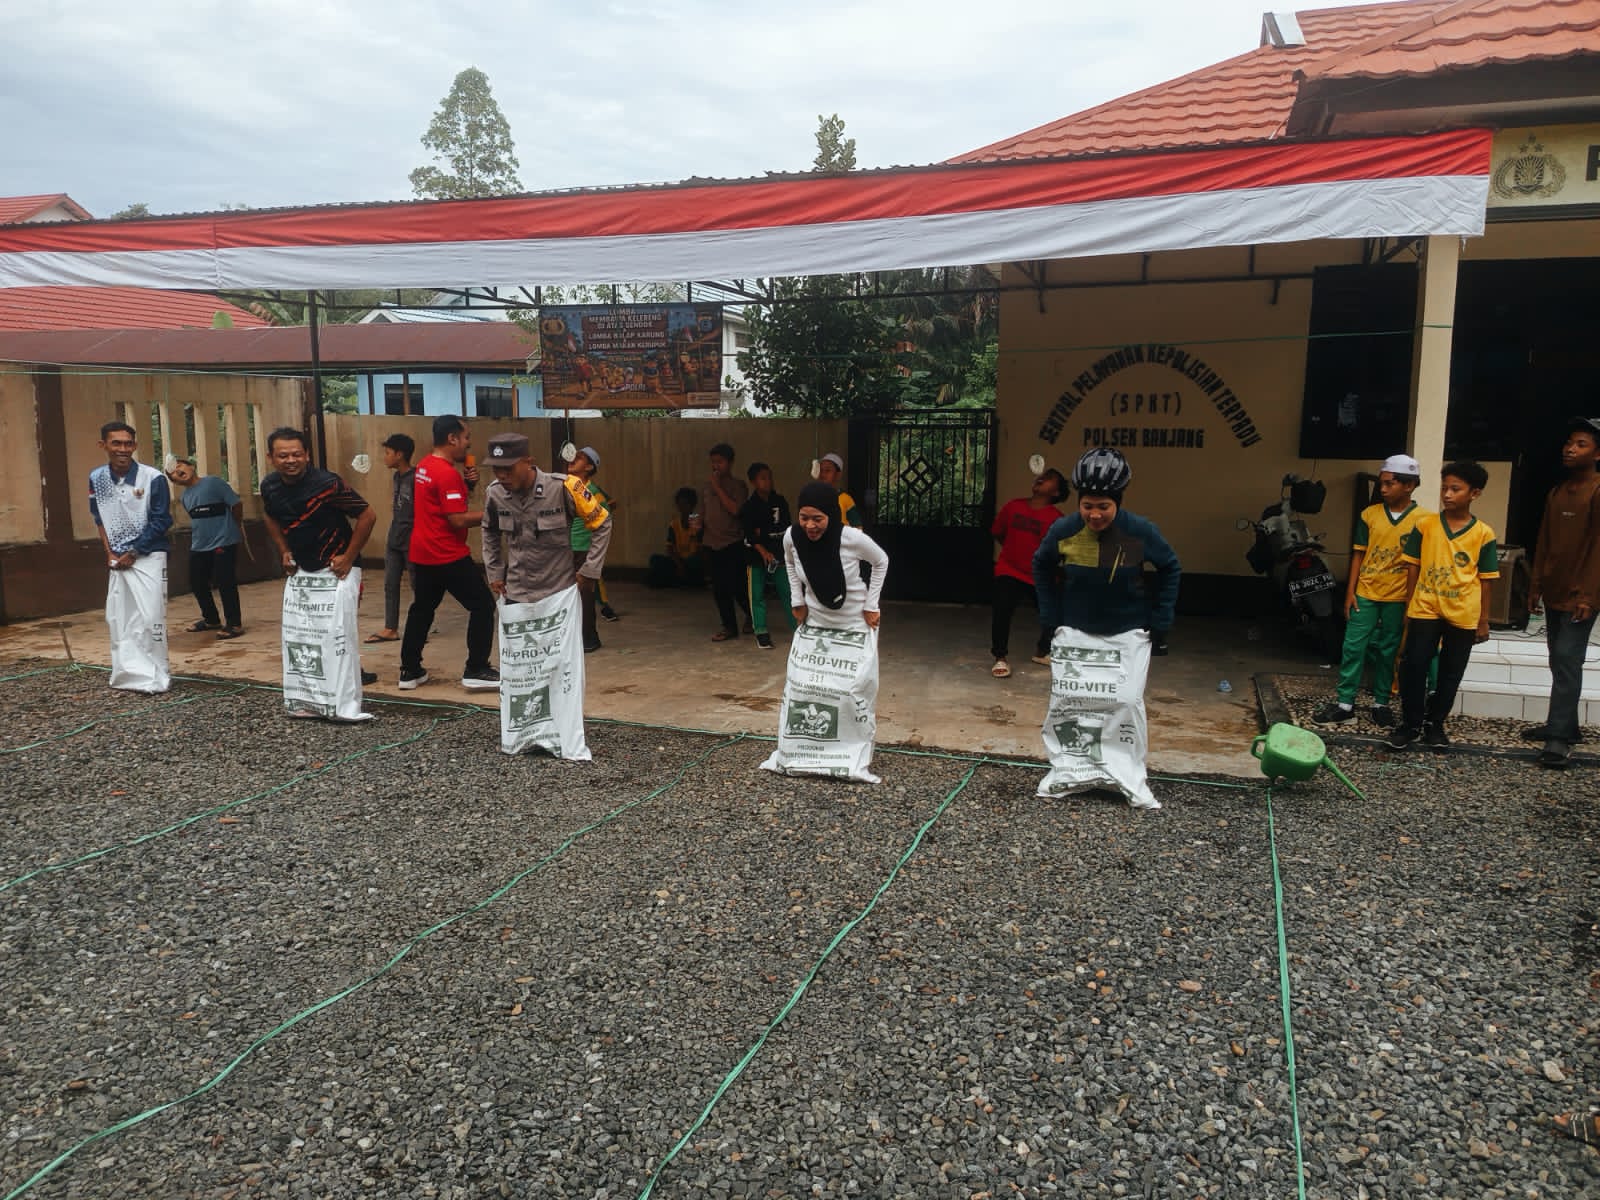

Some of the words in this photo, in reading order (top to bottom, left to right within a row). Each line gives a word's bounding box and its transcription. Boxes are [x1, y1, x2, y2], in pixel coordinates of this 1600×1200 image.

[1083, 427, 1138, 448] POLSEK
[1142, 427, 1204, 448] BANJANG
[1211, 387, 1262, 448] TERPADU
